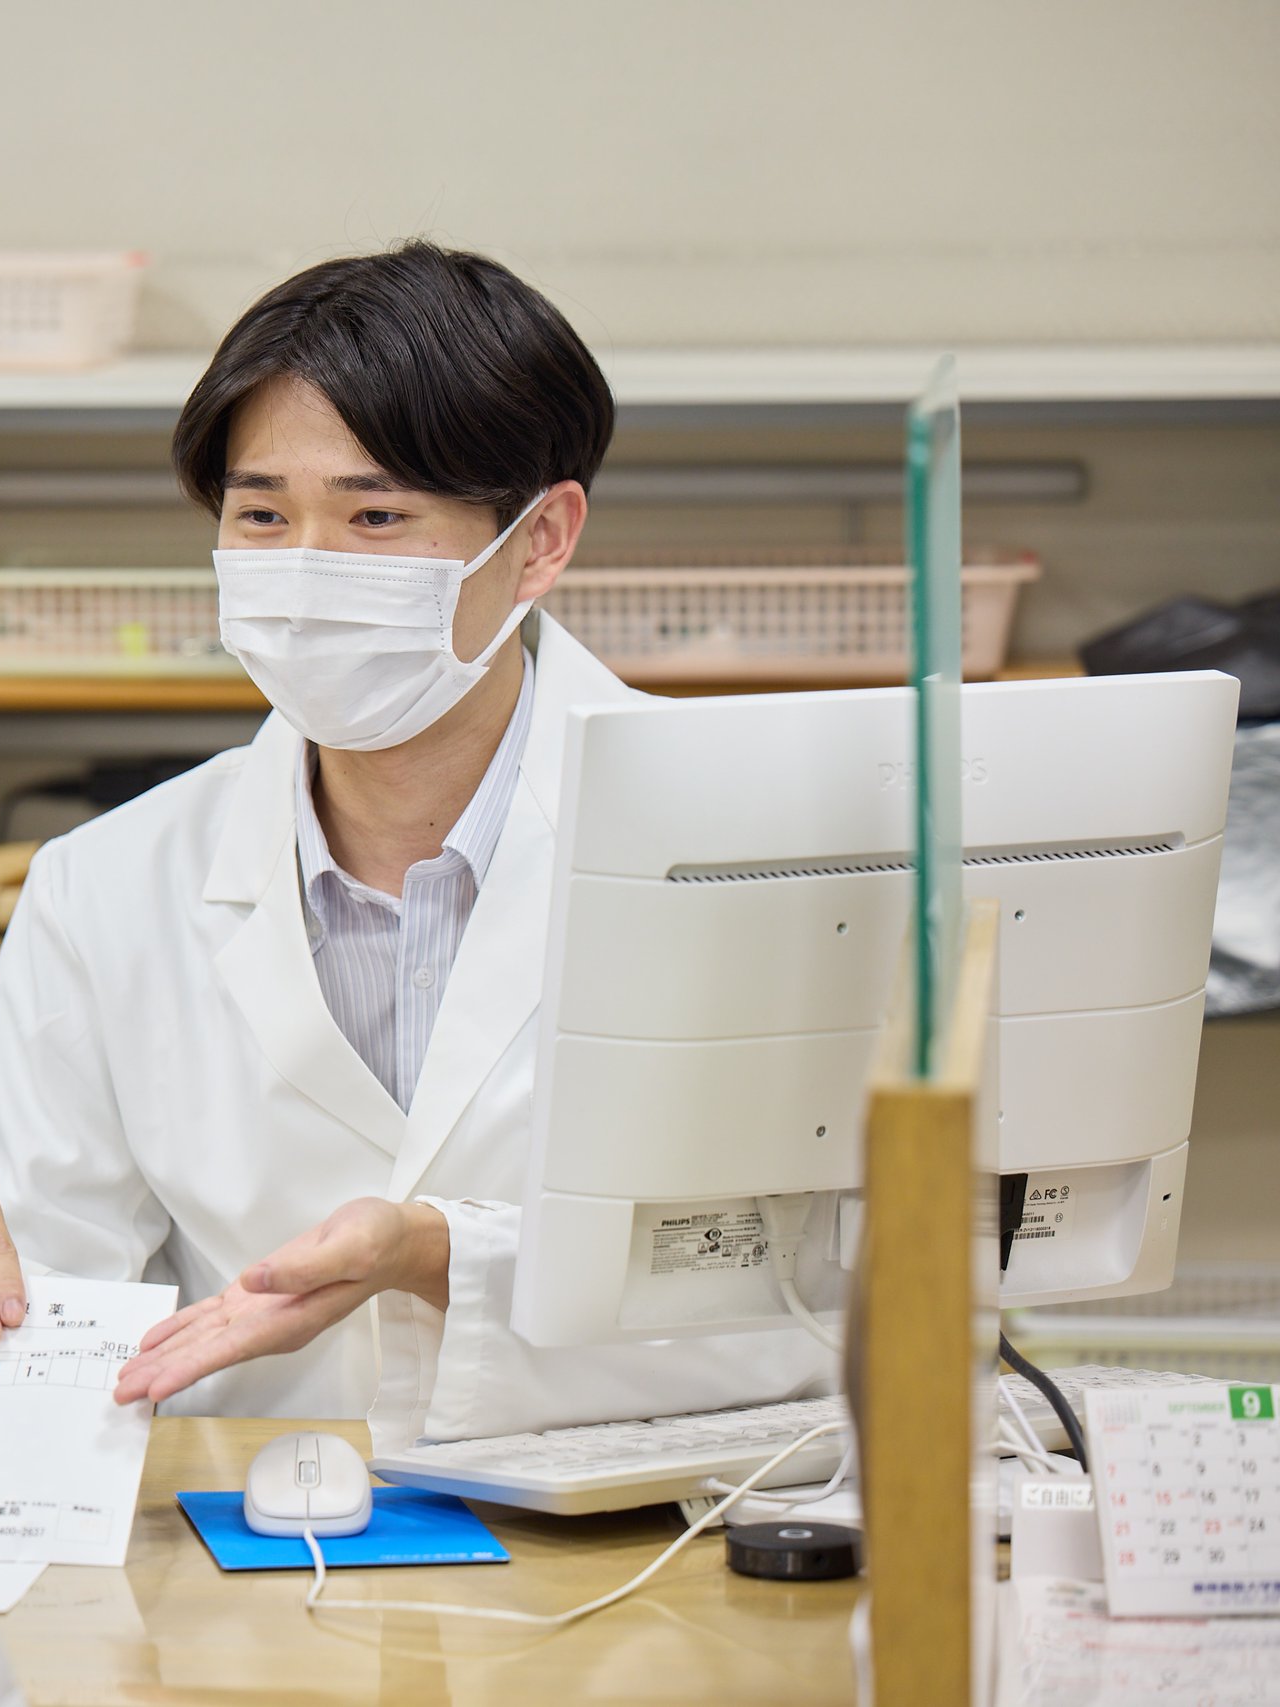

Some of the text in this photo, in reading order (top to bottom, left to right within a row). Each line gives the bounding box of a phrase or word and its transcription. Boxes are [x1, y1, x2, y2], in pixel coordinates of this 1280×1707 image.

[661, 1218, 690, 1227] PHILIPS
[48, 1303, 65, 1317] 薬
[56, 1319, 98, 1329] 様のお薬
[1241, 1390, 1262, 1418] 9
[1241, 1459, 1258, 1475] 10
